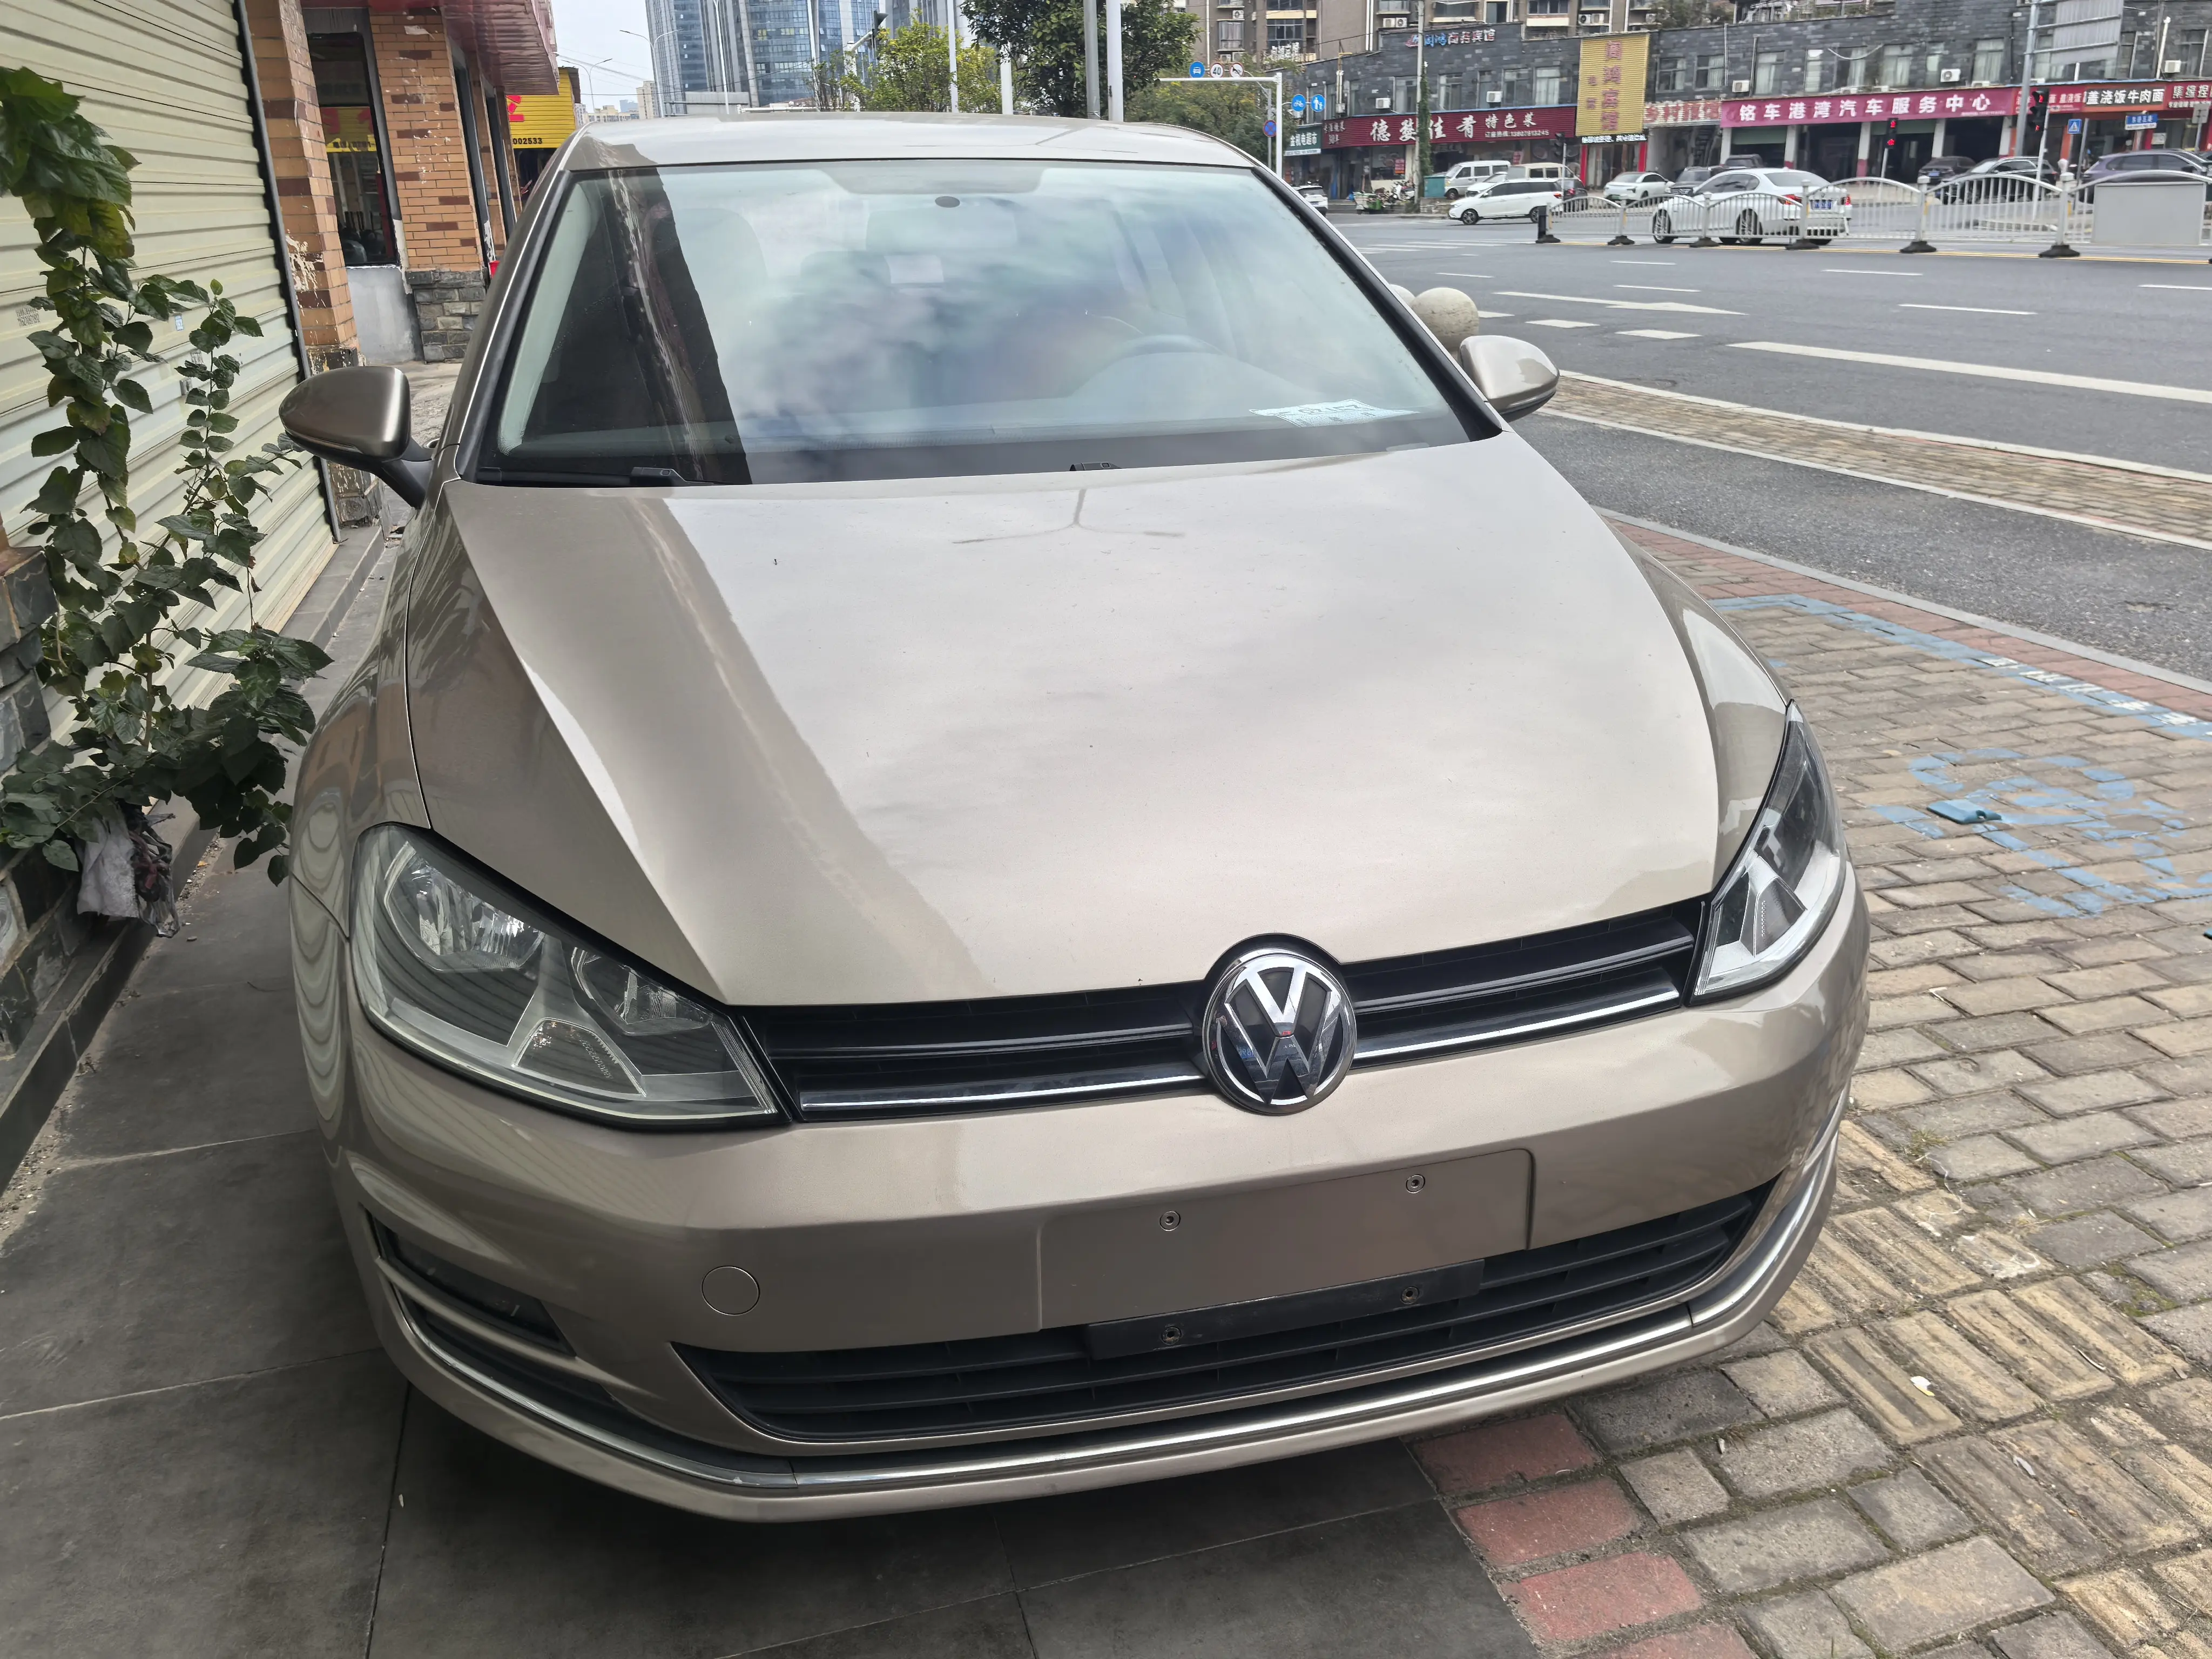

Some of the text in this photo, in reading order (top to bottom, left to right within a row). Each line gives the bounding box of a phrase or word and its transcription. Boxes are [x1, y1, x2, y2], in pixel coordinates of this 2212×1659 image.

[1212, 66, 1221, 76] 40
[2086, 89, 2165, 105] 盖浇饭牛肉面
[1739, 93, 1991, 122] 铭车港湾汽车服务中心
[1485, 112, 1537, 129] 特色菜
